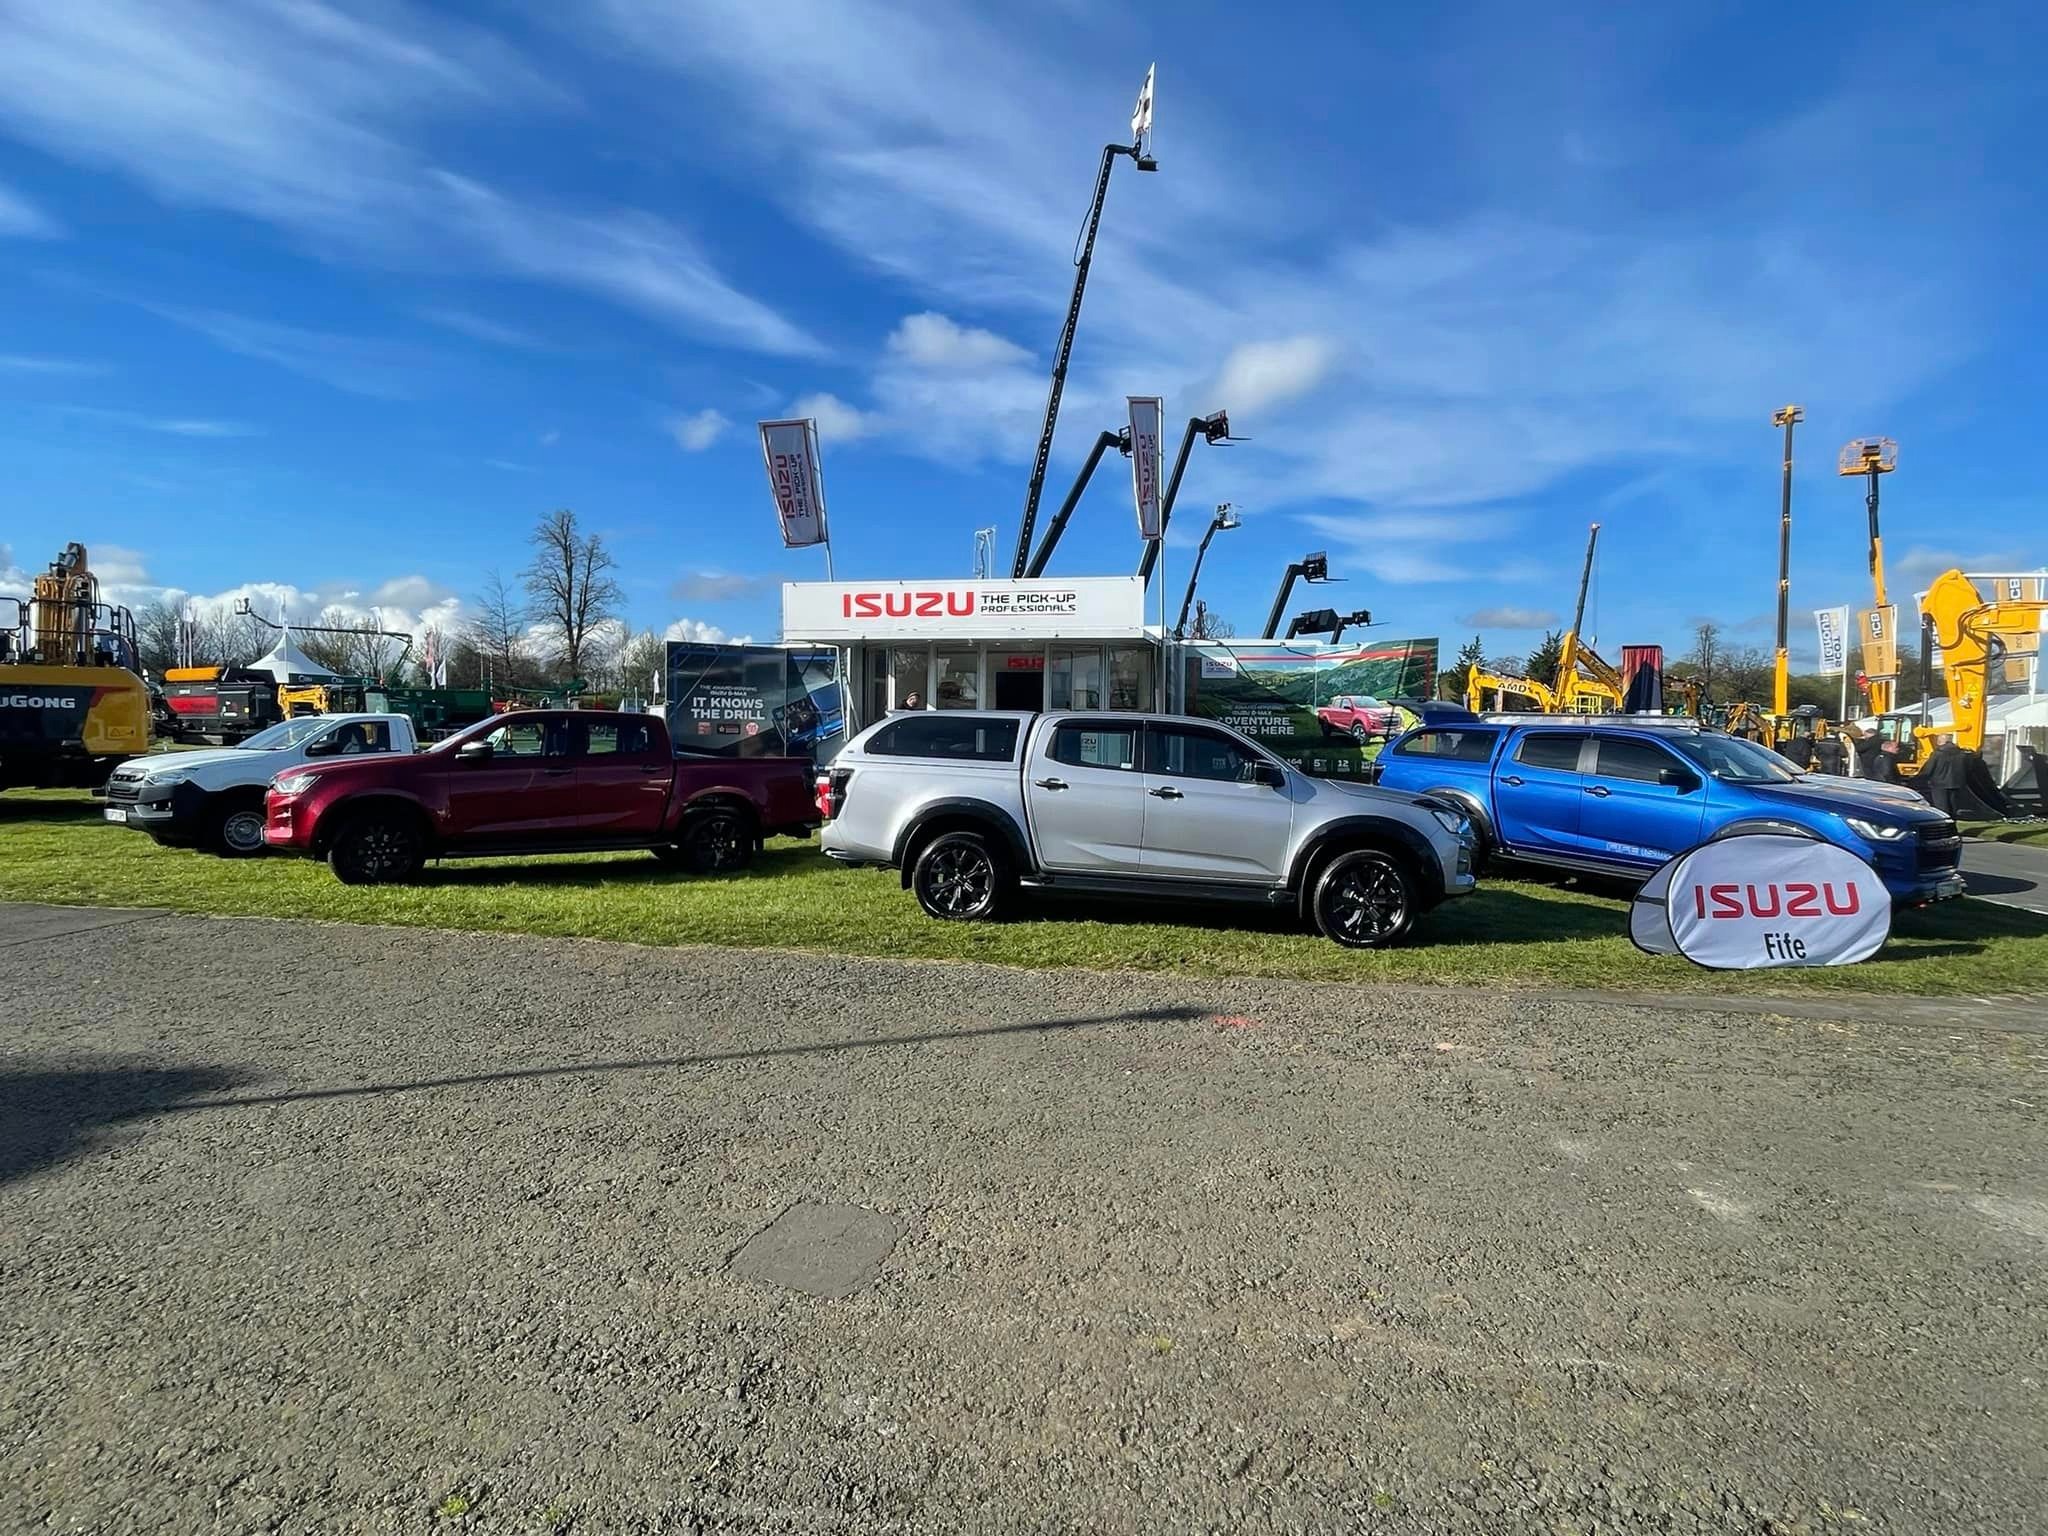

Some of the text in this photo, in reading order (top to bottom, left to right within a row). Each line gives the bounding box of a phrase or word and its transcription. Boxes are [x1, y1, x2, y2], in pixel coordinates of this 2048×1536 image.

[776, 454, 796, 519] ISUZU
[2010, 578, 2021, 600] CB
[843, 591, 974, 618] ISUZU
[981, 593, 1076, 604] THE PICK-UP
[981, 604, 1076, 613] PROFESSIONALS
[693, 697, 764, 709] IT KNOWS
[691, 708, 766, 720] THE DRILL
[1234, 725, 1295, 735] RTS HERE
[1694, 881, 1861, 920] ISUZU
[1763, 932, 1807, 960] Fife
